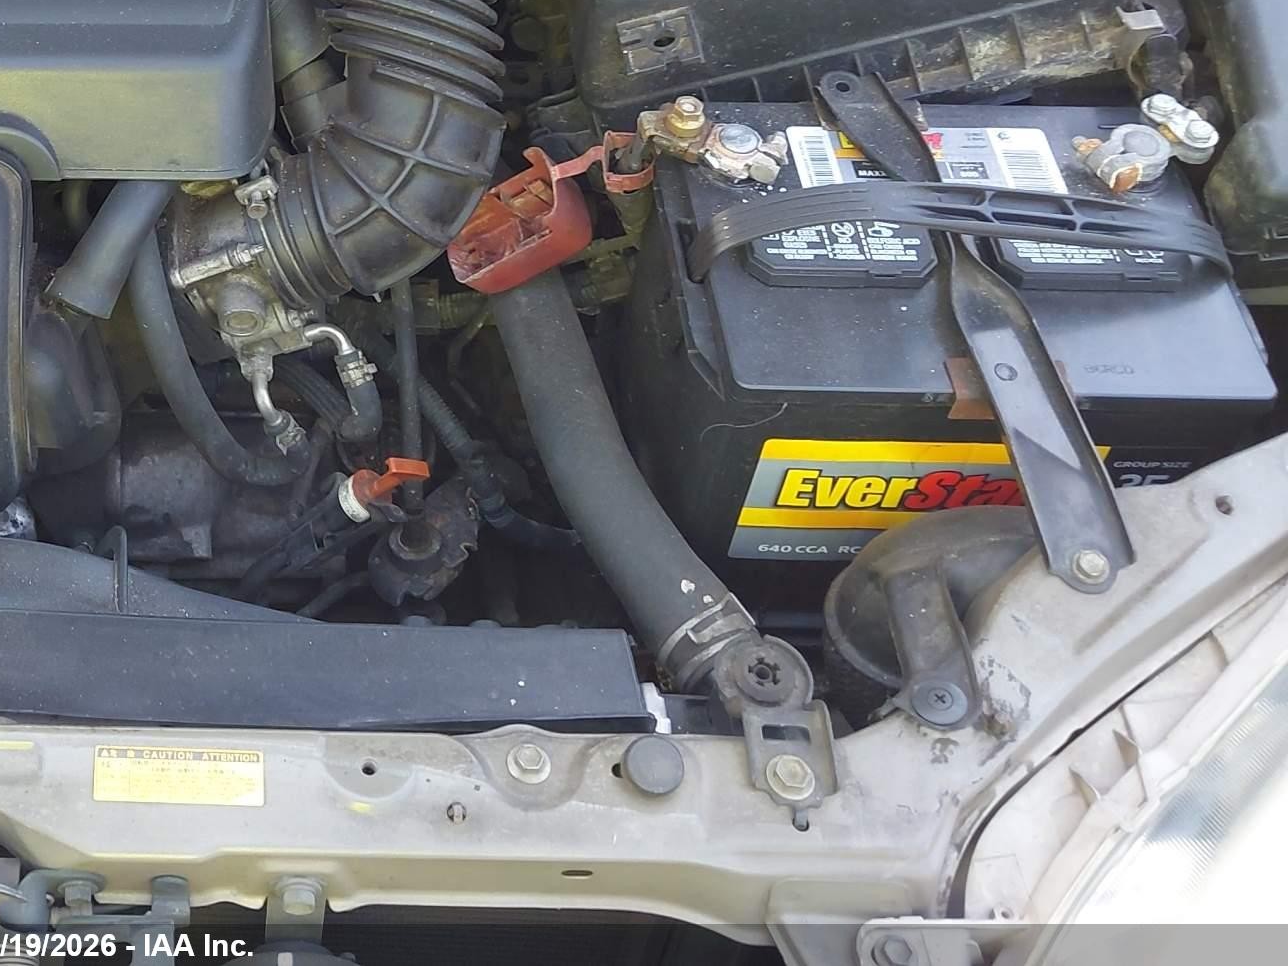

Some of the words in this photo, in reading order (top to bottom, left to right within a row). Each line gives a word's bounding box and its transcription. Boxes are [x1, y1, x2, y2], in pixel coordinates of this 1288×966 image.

[775, 467, 1025, 510] EverSta
[758, 544, 792, 553] 640
[795, 545, 828, 554] CCA
[143, 749, 193, 761] CAUTION
[201, 751, 258, 763] ATTENTION
